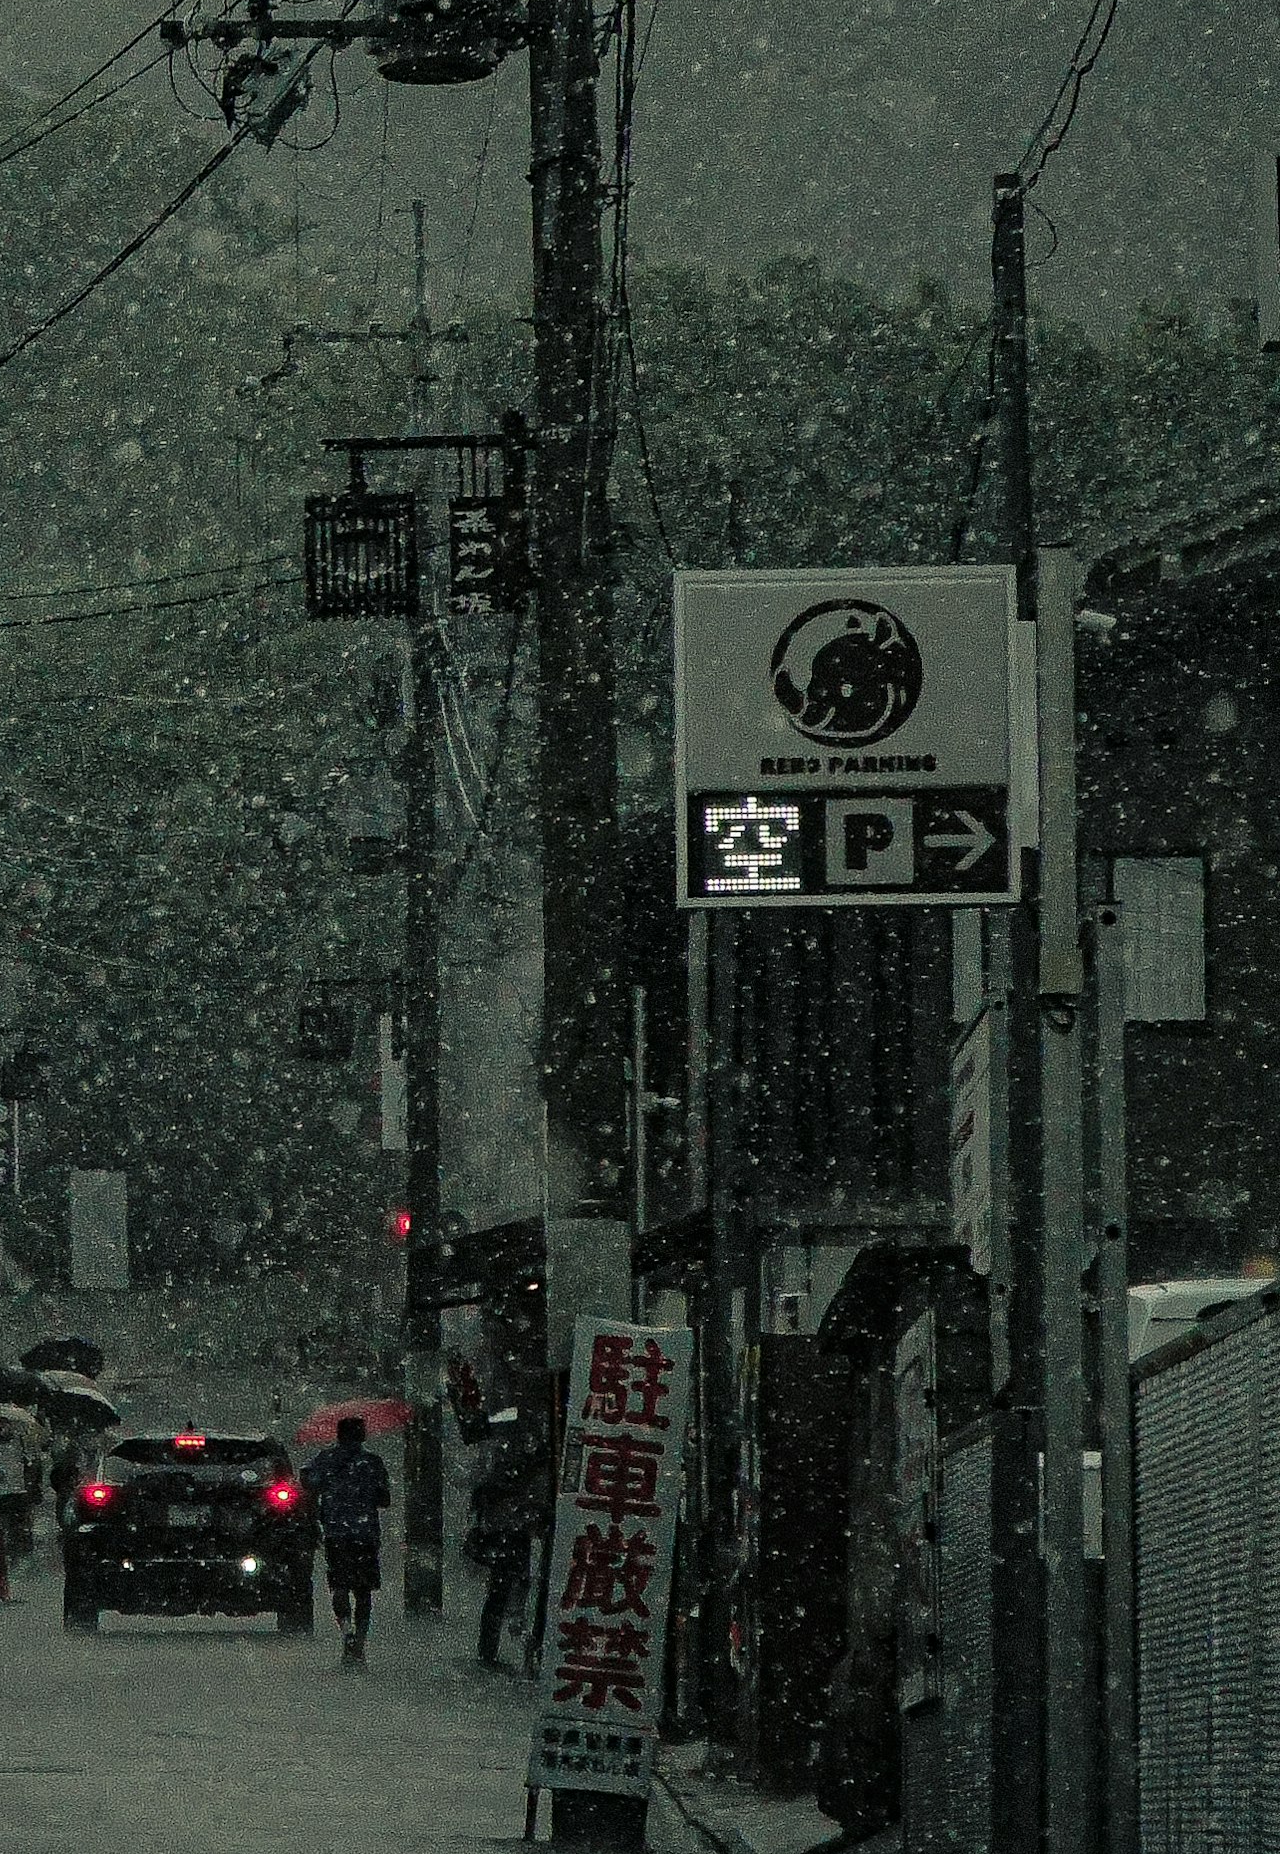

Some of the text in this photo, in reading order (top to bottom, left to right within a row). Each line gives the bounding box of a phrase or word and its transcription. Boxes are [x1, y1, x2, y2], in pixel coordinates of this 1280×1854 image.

[828, 754, 938, 774] PARKING
[704, 796, 801, 891] 空
[844, 814, 895, 870] P
[552, 1334, 675, 1710] 駐車厳禁
